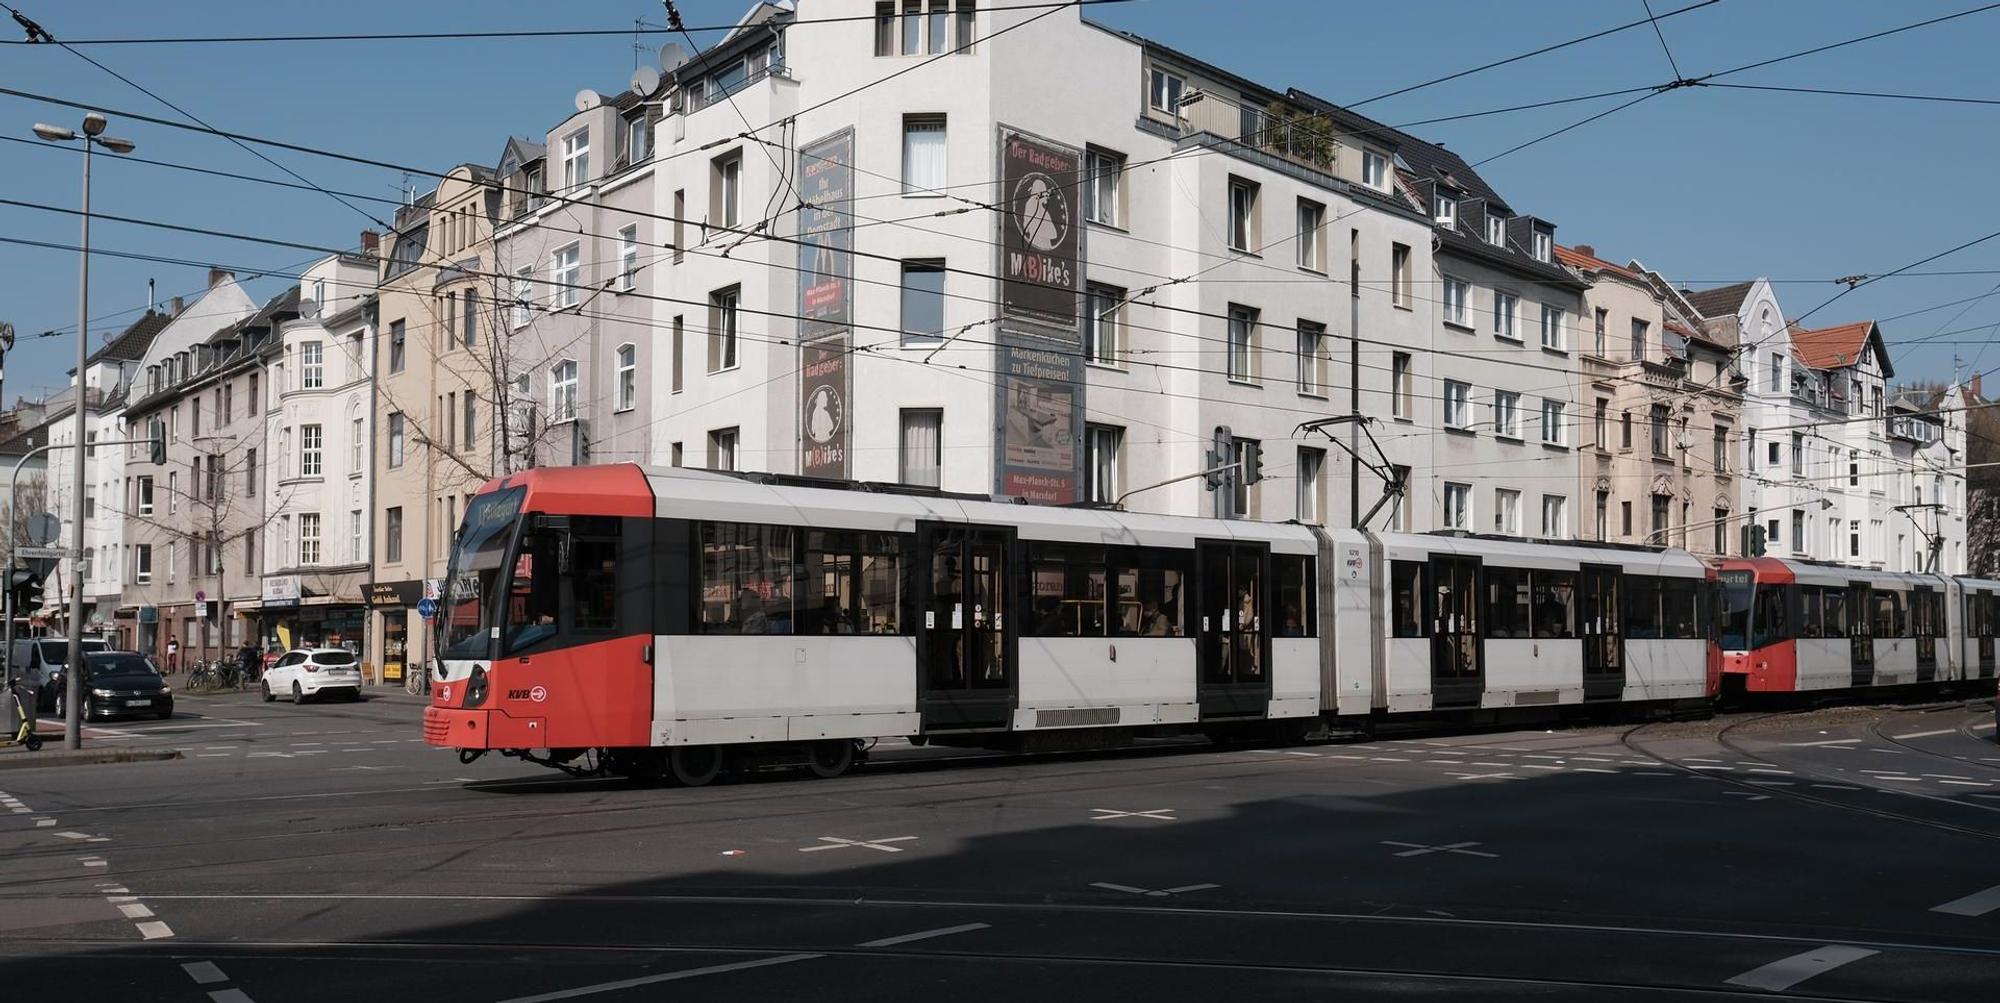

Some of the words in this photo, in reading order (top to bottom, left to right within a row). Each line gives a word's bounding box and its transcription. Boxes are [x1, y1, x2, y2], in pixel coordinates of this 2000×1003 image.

[1012, 142, 1027, 158] Der
[1010, 252, 1070, 286] M(B)ike's
[1012, 362, 1021, 373] zu
[1023, 363, 1070, 381] Tiefpreisen!
[805, 443, 843, 468] M(B)ike's
[508, 689, 531, 699] KVB
